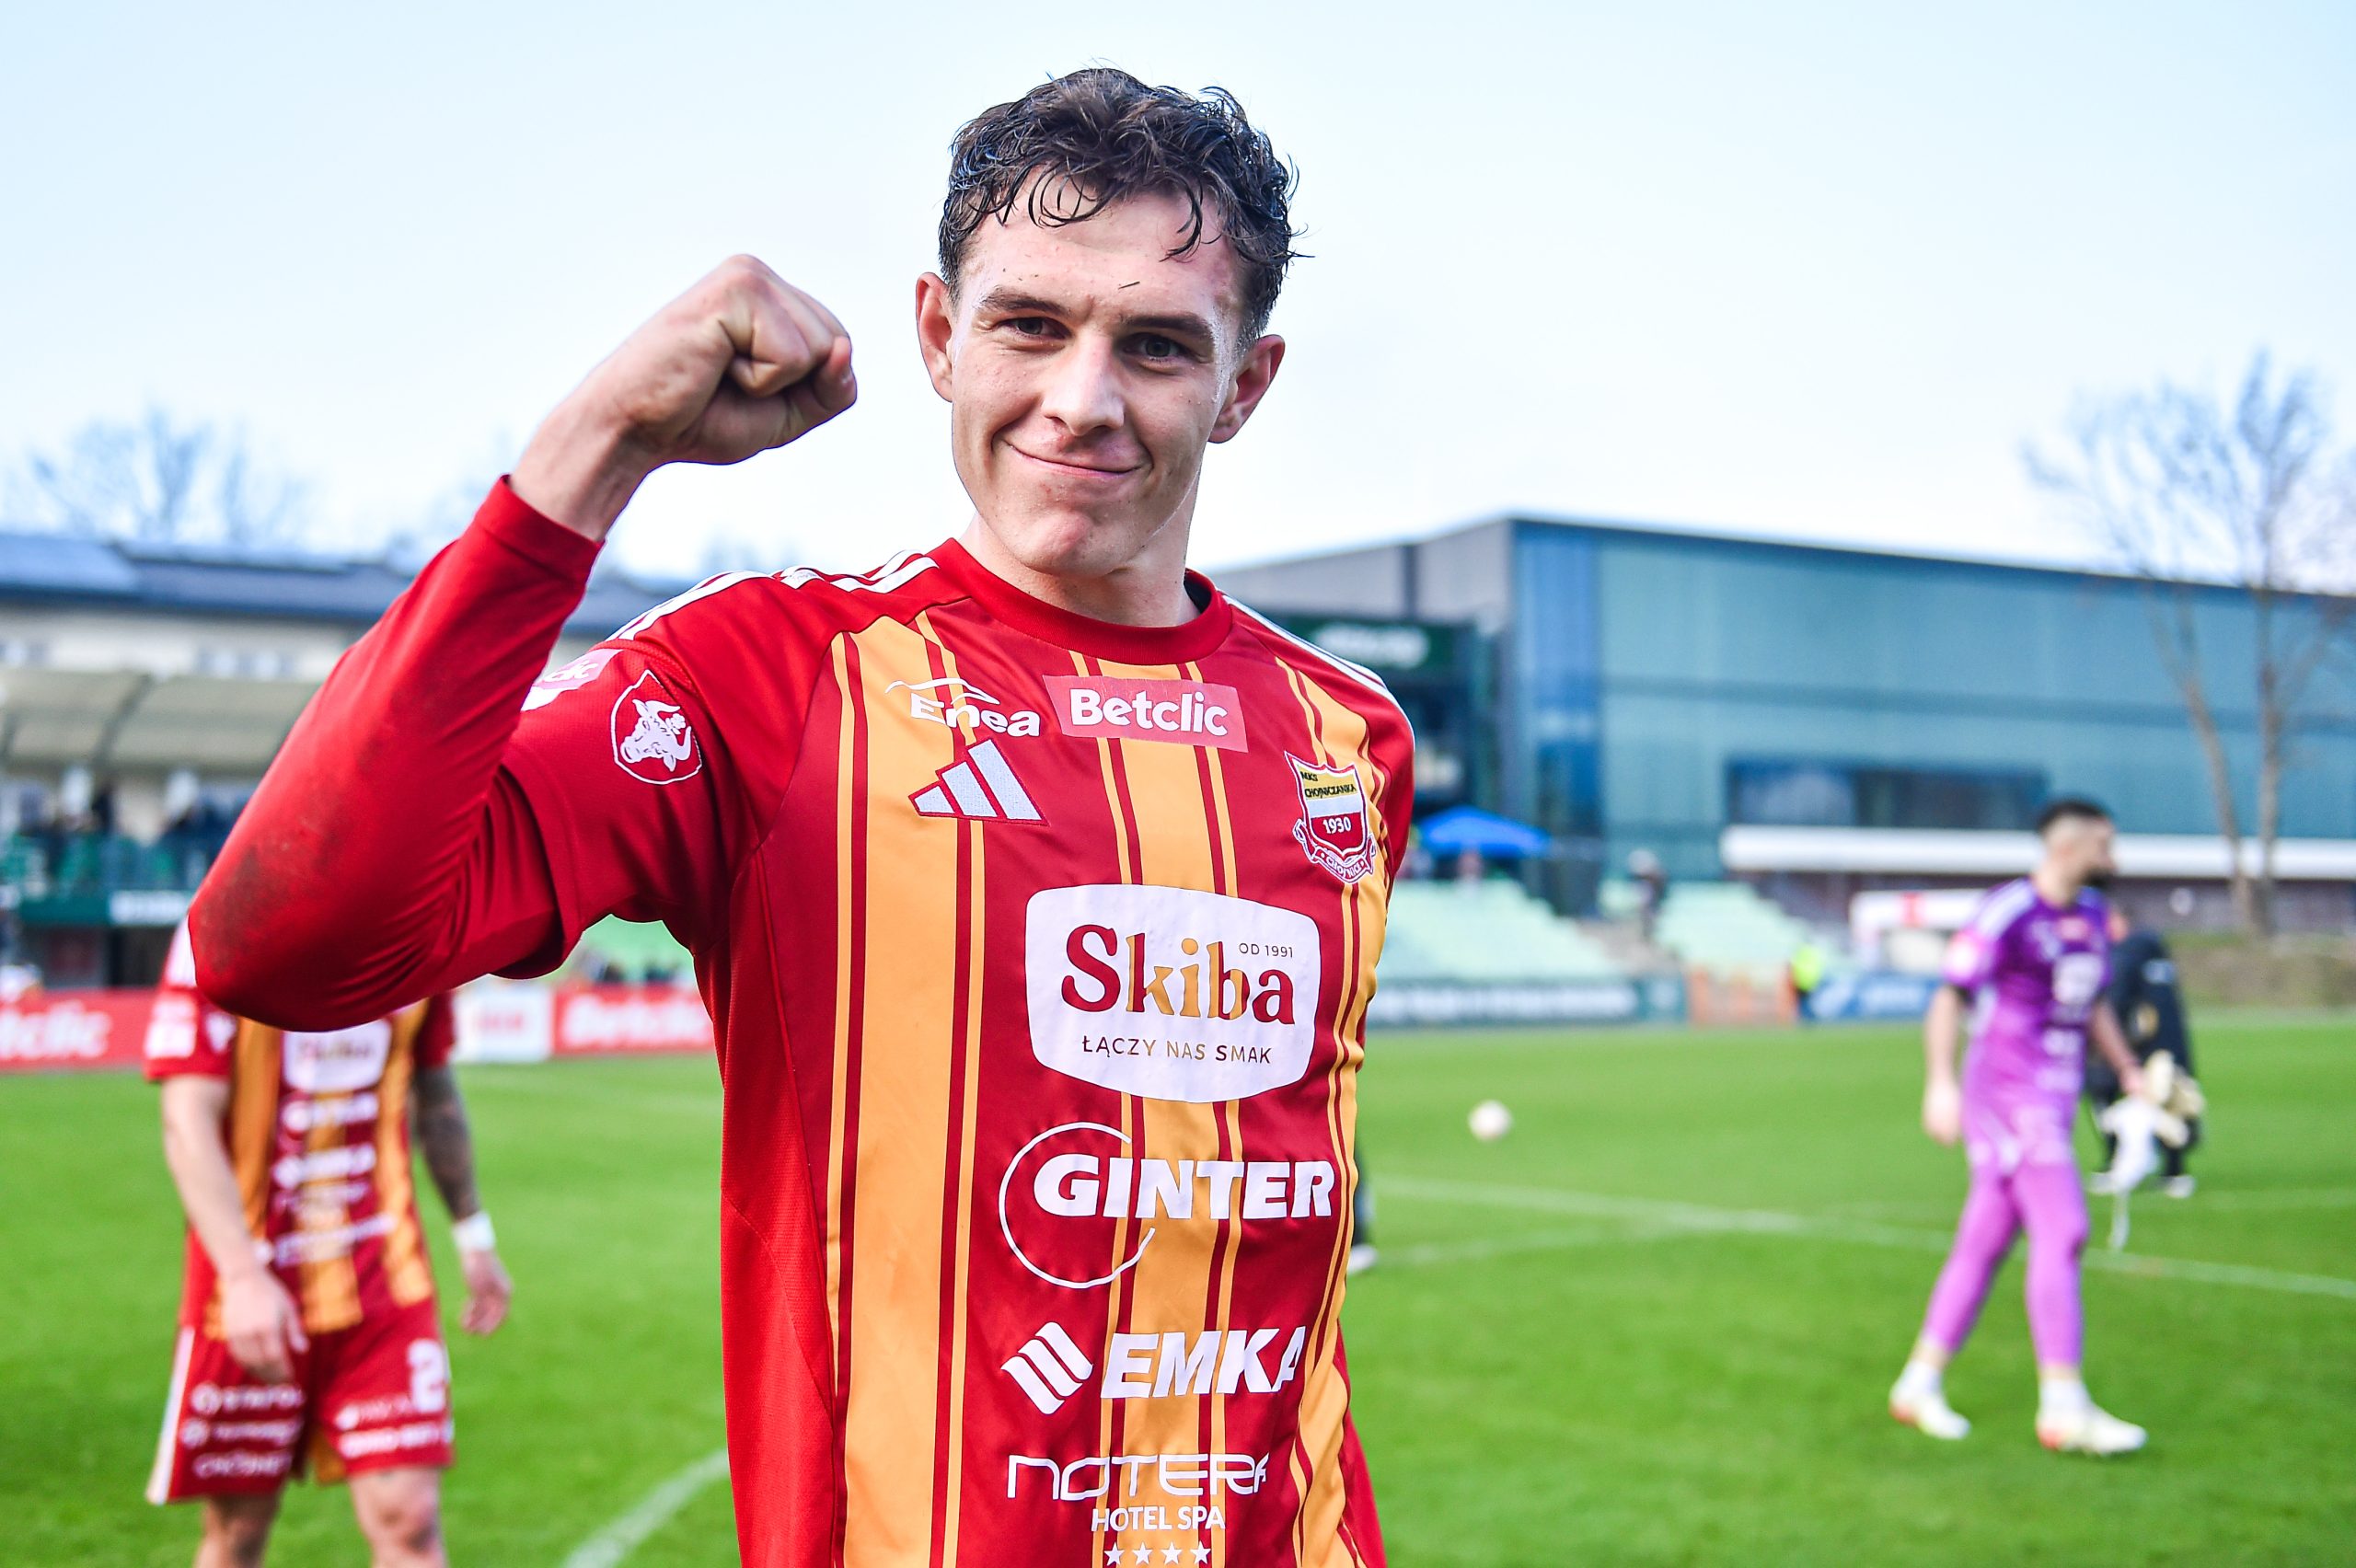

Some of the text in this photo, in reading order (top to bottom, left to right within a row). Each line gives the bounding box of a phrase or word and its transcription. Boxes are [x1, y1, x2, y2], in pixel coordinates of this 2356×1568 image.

[910, 692, 1041, 737] Enea
[1069, 687, 1229, 736] Betclic
[1300, 771, 1318, 781] MKS
[1322, 816, 1352, 835] 1930
[1239, 942, 1294, 959] OD 1991
[1061, 924, 1296, 1025] Skiba
[1081, 1035, 1273, 1065] ŁĄCZY NAS SMAK
[1033, 1153, 1336, 1219] GINTER
[1100, 1325, 1307, 1399] EMKA
[1091, 1505, 1226, 1532] HOTEL SPA
